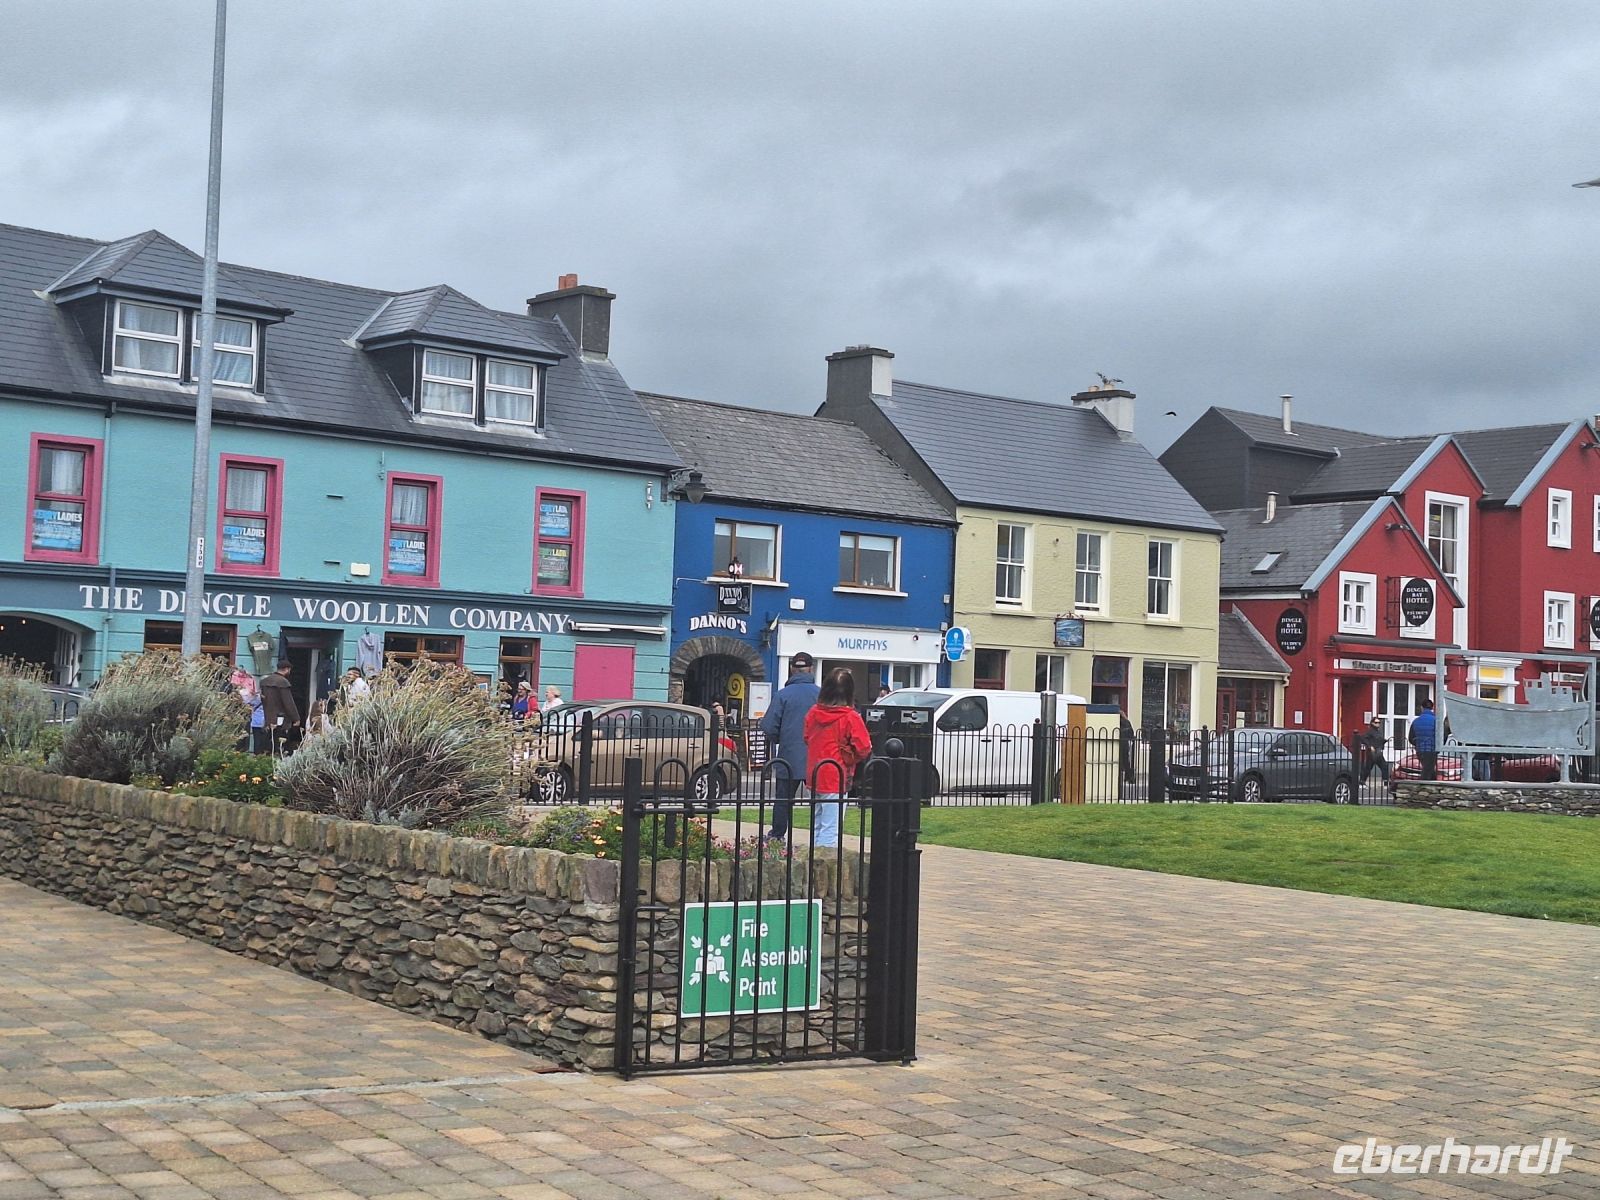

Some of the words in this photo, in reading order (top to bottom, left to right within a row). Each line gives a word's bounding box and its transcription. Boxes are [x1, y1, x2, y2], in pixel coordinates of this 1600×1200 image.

[79, 585, 143, 611] THE
[293, 598, 430, 626] WOOLLEN
[449, 607, 570, 634] COMPANY
[690, 614, 747, 634] DANNO'S
[838, 637, 888, 651] MURPHYS
[739, 976, 777, 998] Point
